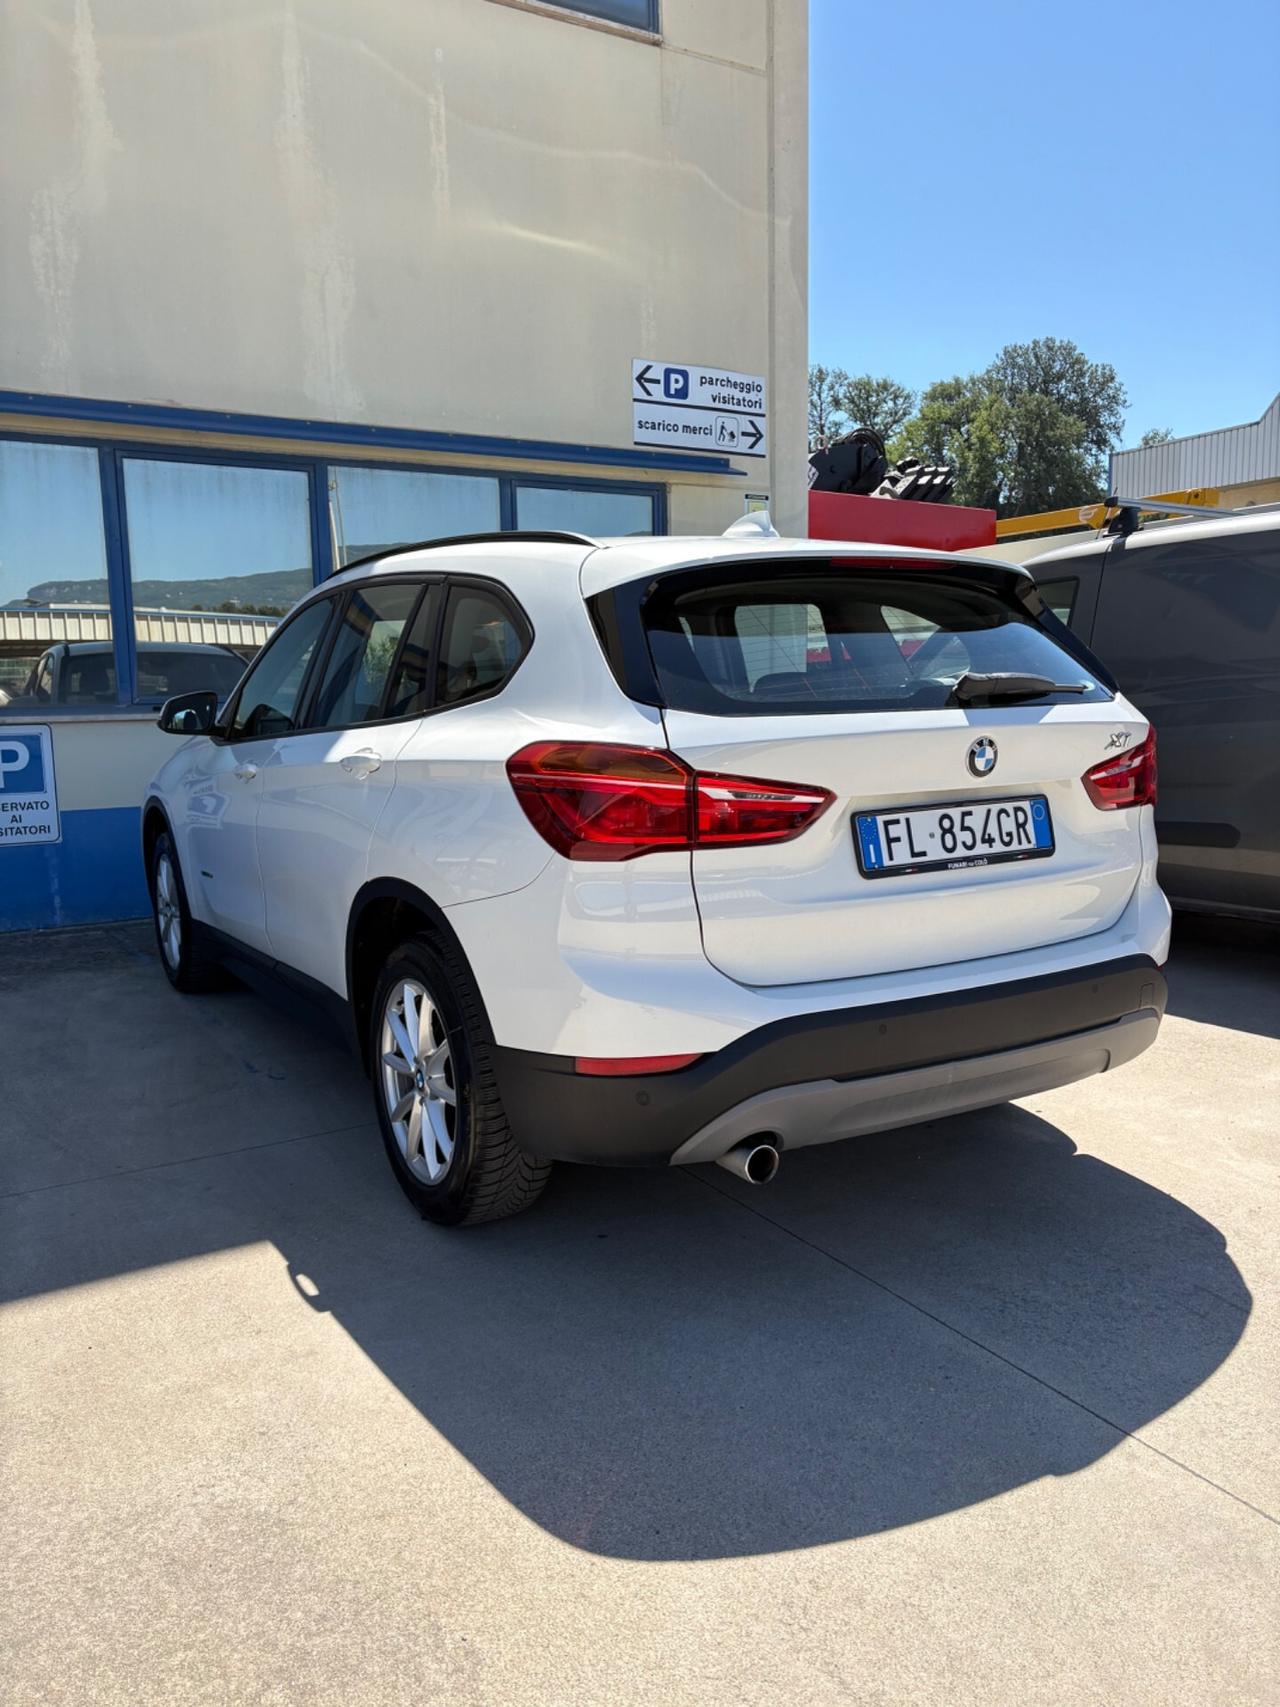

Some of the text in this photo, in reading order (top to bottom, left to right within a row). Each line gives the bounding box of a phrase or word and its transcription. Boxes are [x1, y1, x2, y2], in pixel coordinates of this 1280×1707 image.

[669, 373, 685, 395] P
[699, 375, 763, 394] parcheggio
[711, 393, 763, 409] visitatori
[637, 419, 713, 436] scarico merci
[0, 740, 30, 789] P
[10, 814, 22, 824] AI
